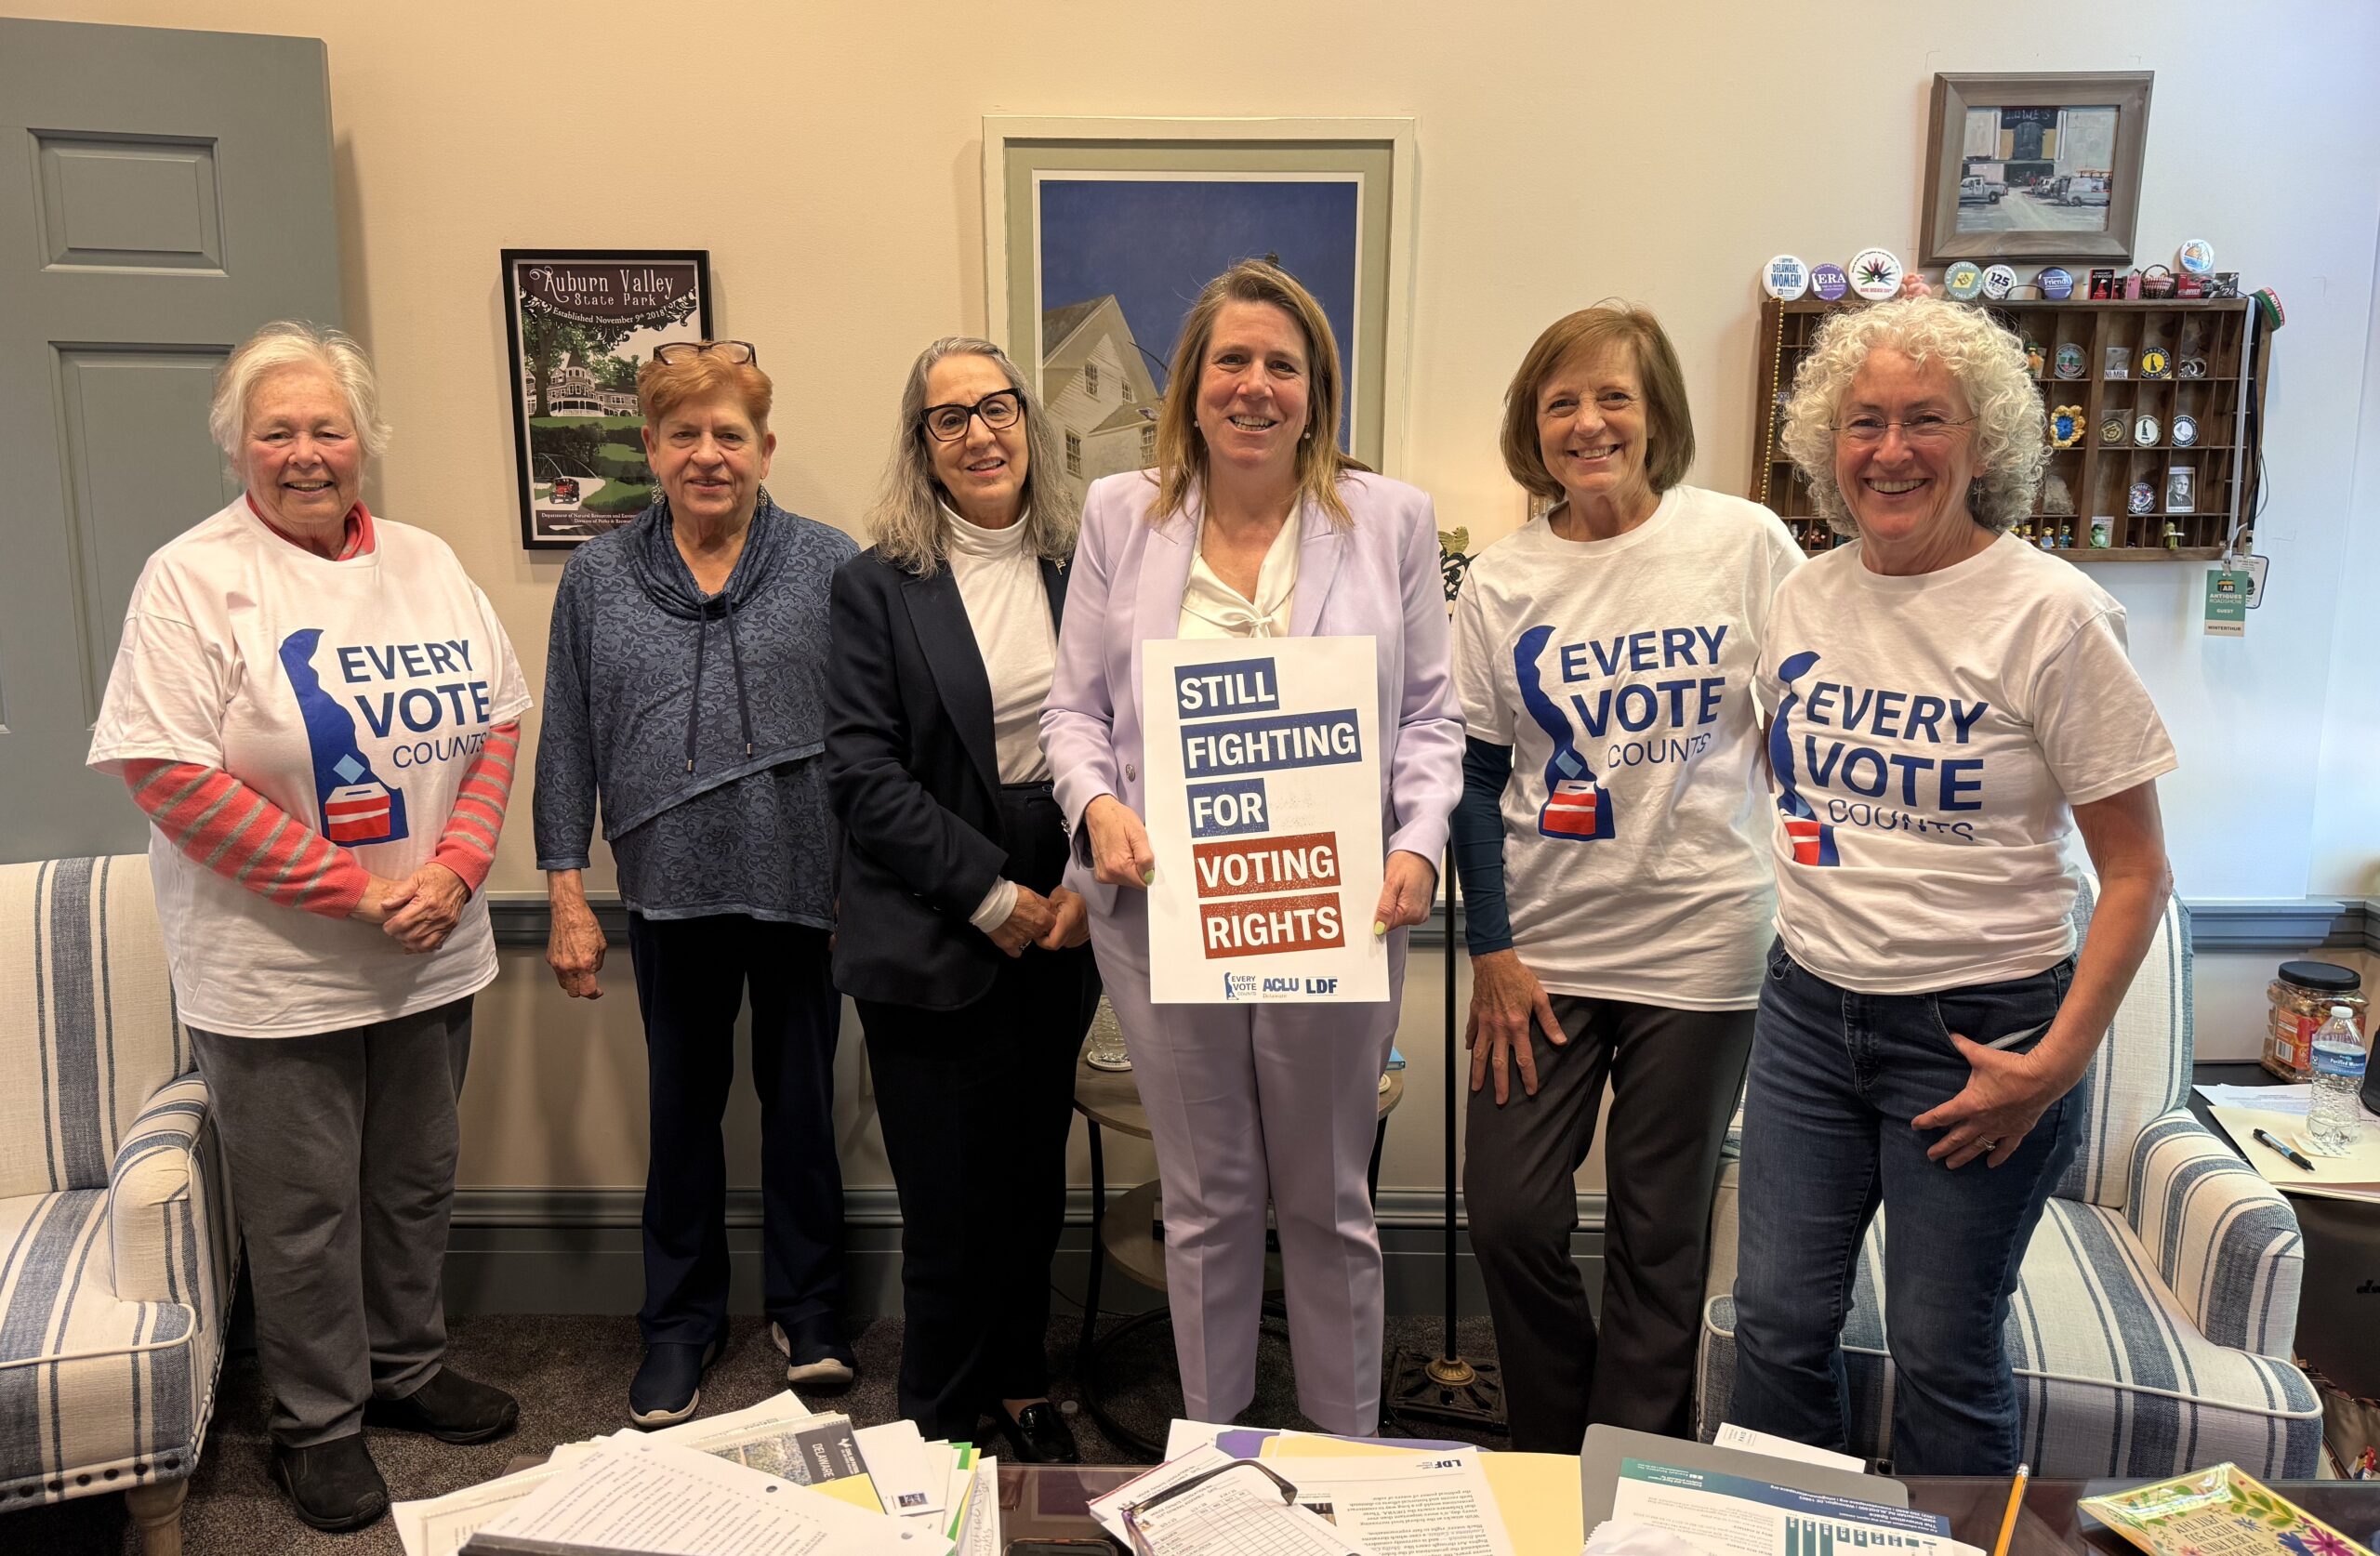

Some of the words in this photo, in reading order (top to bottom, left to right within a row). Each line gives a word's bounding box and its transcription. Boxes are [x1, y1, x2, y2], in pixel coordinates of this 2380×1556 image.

[529, 266, 608, 303] Auburn
[620, 269, 673, 300] Valley
[1771, 274, 1801, 288] WOMEN!
[1773, 264, 1799, 273] DELAWARE
[1818, 274, 1846, 284] ERA
[1946, 263, 1975, 283] LEAD-FREE
[1990, 272, 2009, 286] 125
[574, 293, 614, 305] State
[623, 293, 656, 306] Park
[1955, 280, 1982, 298] DELAWARE
[553, 307, 593, 323] Established
[337, 640, 473, 683] EVERY
[1560, 625, 1728, 683] EVERY
[1180, 672, 1275, 710] STILL
[1570, 677, 1725, 738] VOTE
[354, 681, 490, 738] VOTE
[1806, 682, 1989, 744] EVERY
[393, 732, 487, 768] COUNTS
[1187, 723, 1357, 769] FIGHTING
[1608, 733, 1711, 768] COUNTS
[1805, 735, 1983, 811] VOTE
[1193, 792, 1264, 828] FOR
[1828, 799, 1974, 841] COUNTS
[1198, 845, 1335, 888] VOTING
[1207, 906, 1339, 949] RIGHTS
[1263, 978, 1299, 992] ACLU
[1306, 979, 1338, 994] LDF
[812, 1442, 834, 1477] DELAWARE
[1434, 1459, 1461, 1468] LDF
[1889, 1516, 1922, 1525] Innovation
[2185, 1532, 2205, 1544] YOU
